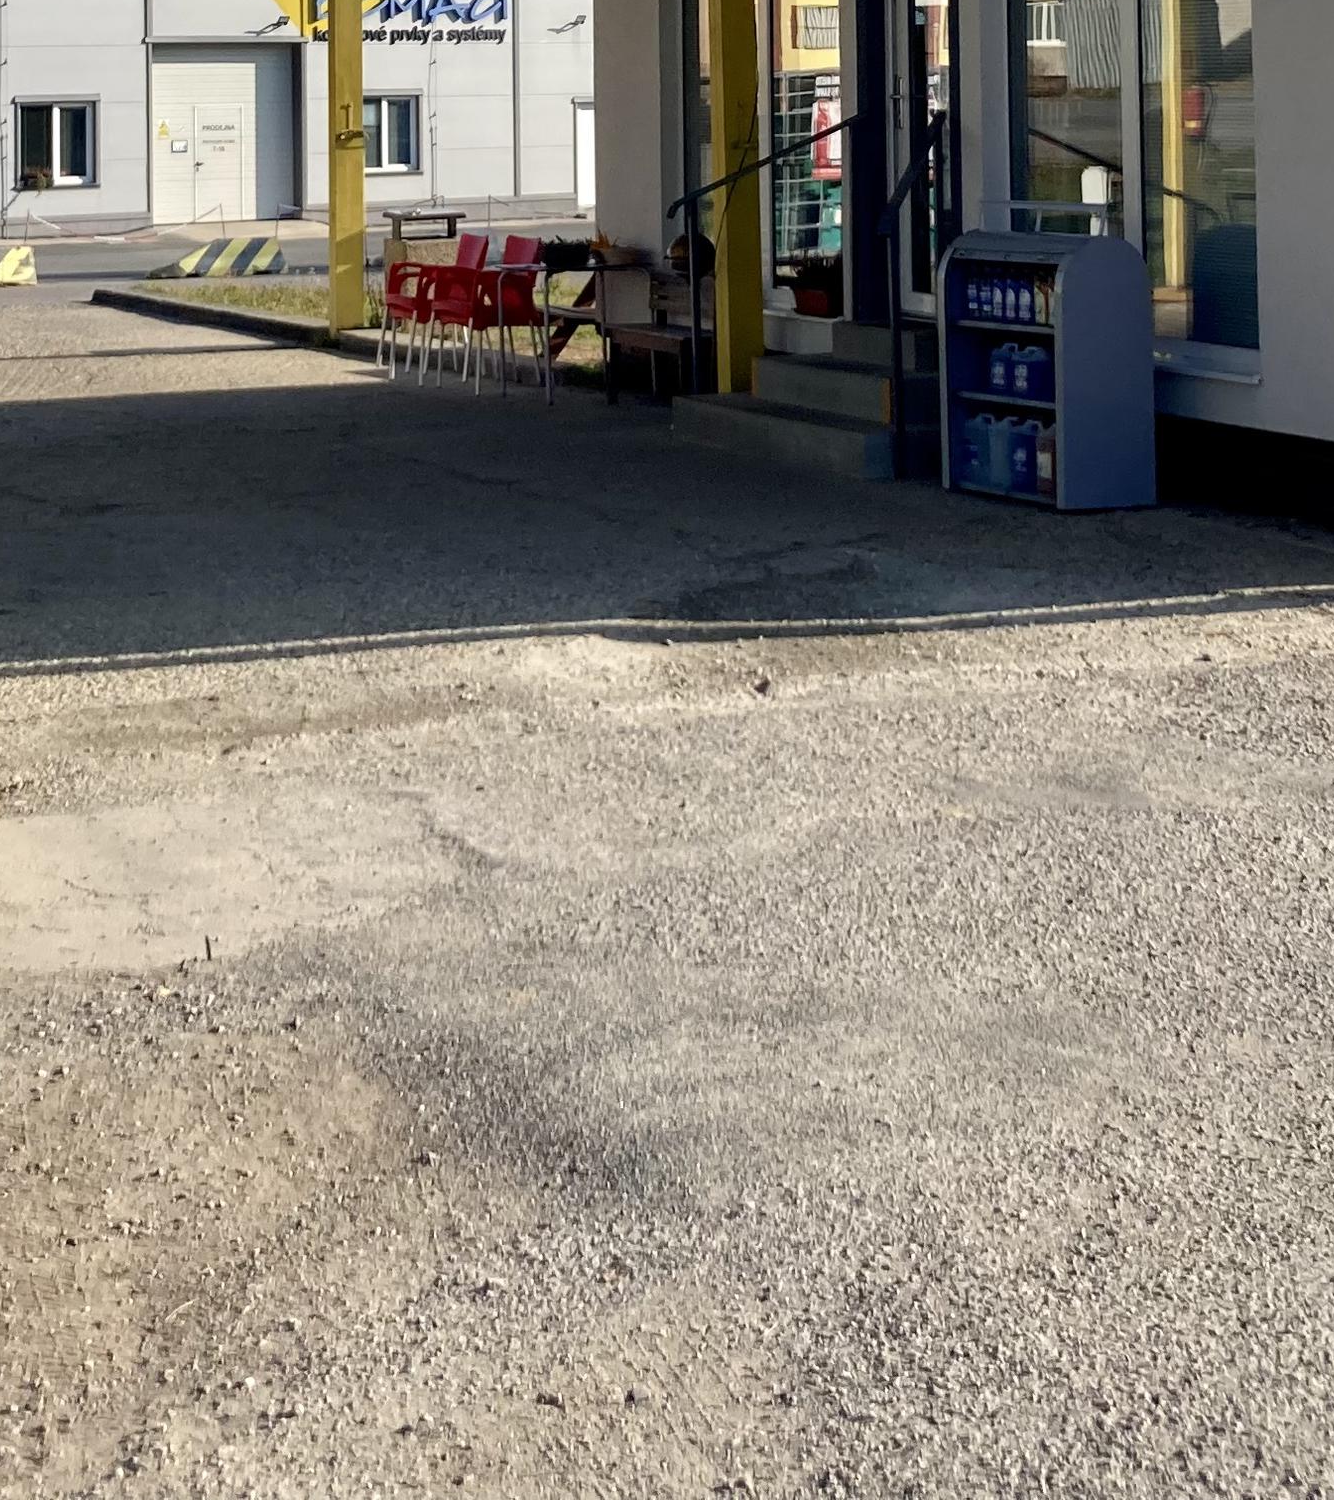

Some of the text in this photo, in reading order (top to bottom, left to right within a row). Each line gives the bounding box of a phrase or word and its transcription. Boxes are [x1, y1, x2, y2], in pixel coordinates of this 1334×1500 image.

[390, 27, 431, 45] prvky
[432, 30, 443, 42] a
[446, 25, 506, 45] systémy
